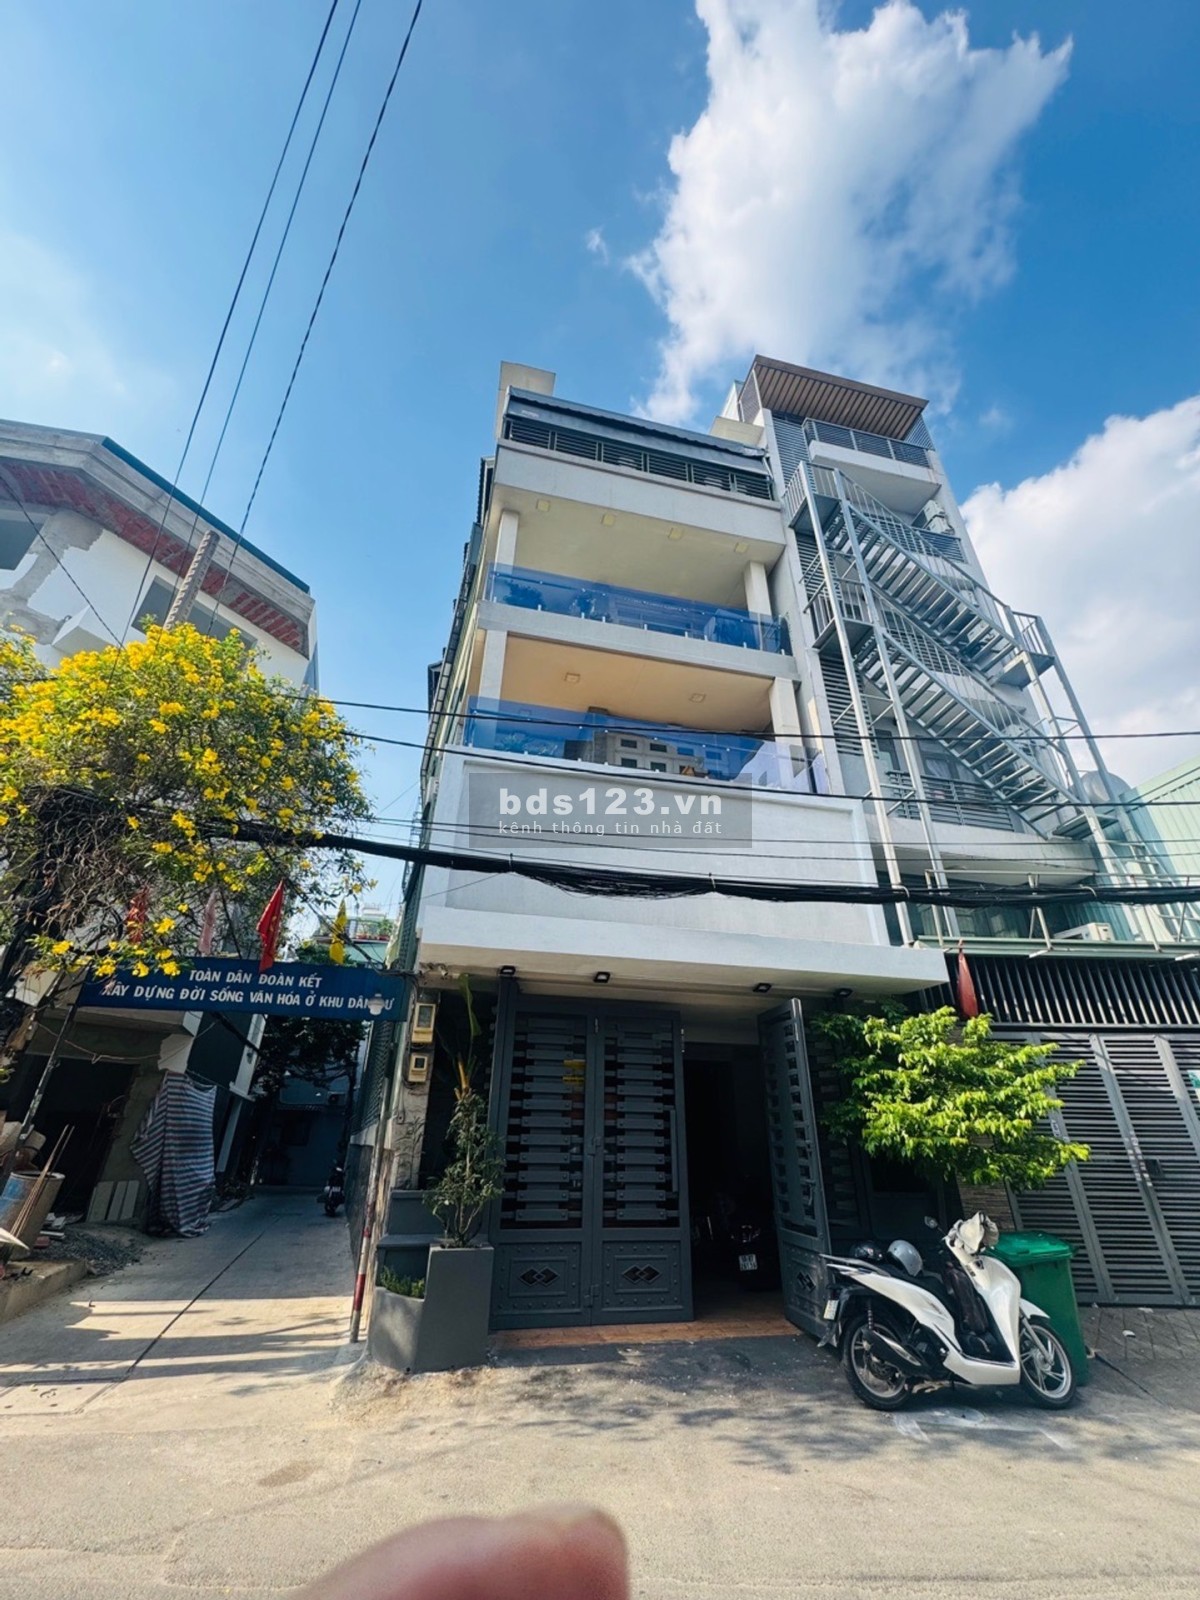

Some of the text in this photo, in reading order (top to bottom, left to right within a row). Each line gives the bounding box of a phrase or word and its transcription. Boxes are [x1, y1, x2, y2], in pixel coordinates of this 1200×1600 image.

[189, 968, 322, 988] TOÀN DÂN ĐOÀN KẾT
[134, 985, 175, 1001] DỰNG
[180, 985, 206, 1000] ĐỜI
[209, 986, 244, 1002] SỐNG
[250, 991, 274, 1004] VĂN
[276, 990, 300, 1006] HÓA
[305, 990, 317, 1007] Ở
[319, 996, 344, 1008] KHU
